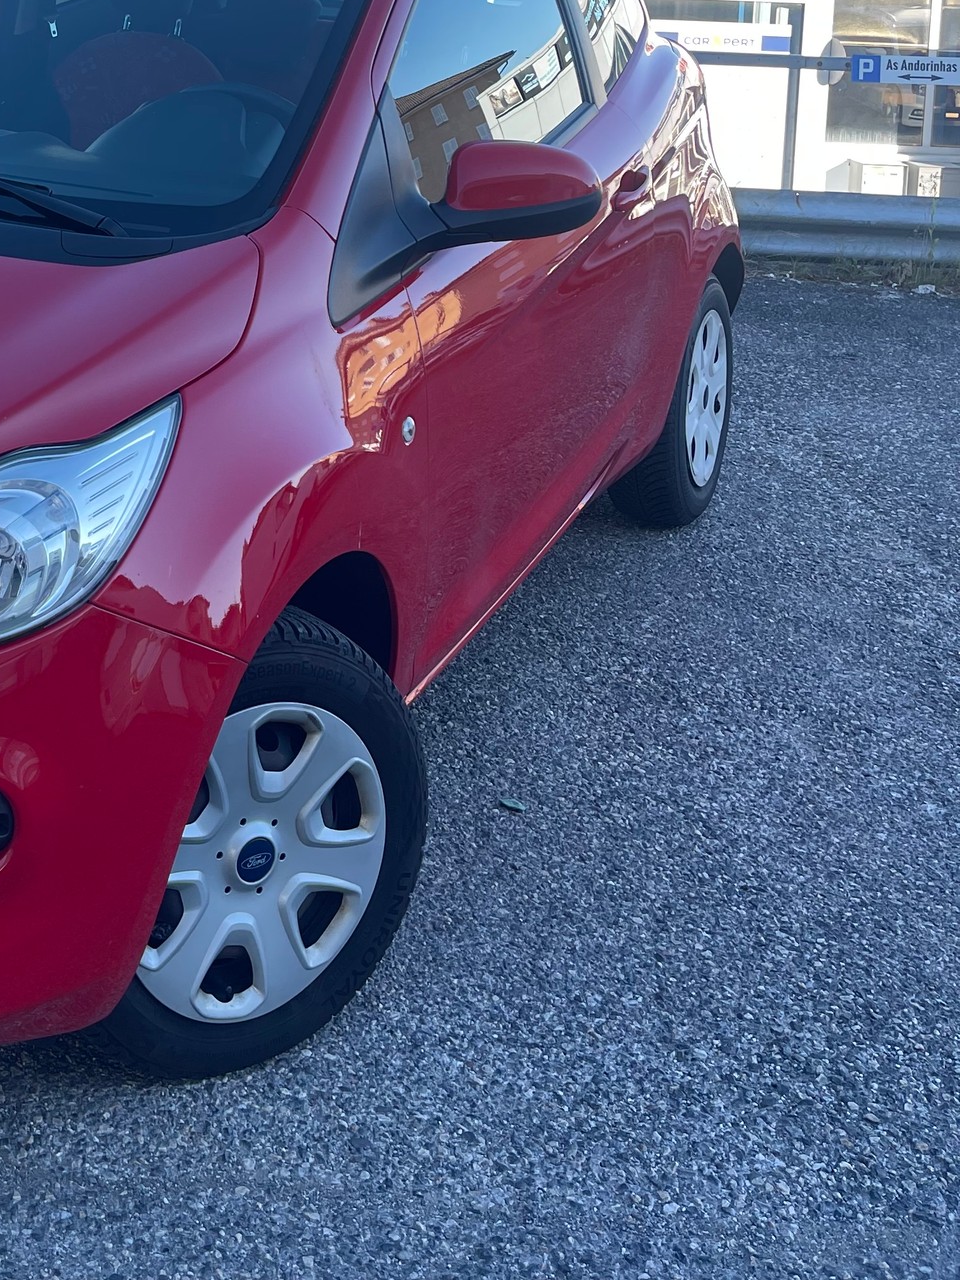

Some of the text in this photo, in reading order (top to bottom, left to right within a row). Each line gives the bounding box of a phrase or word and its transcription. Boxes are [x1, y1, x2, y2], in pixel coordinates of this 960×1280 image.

[858, 58, 958, 81] P As Andorinhas
[321, 871, 412, 1010] UNIROYAL
